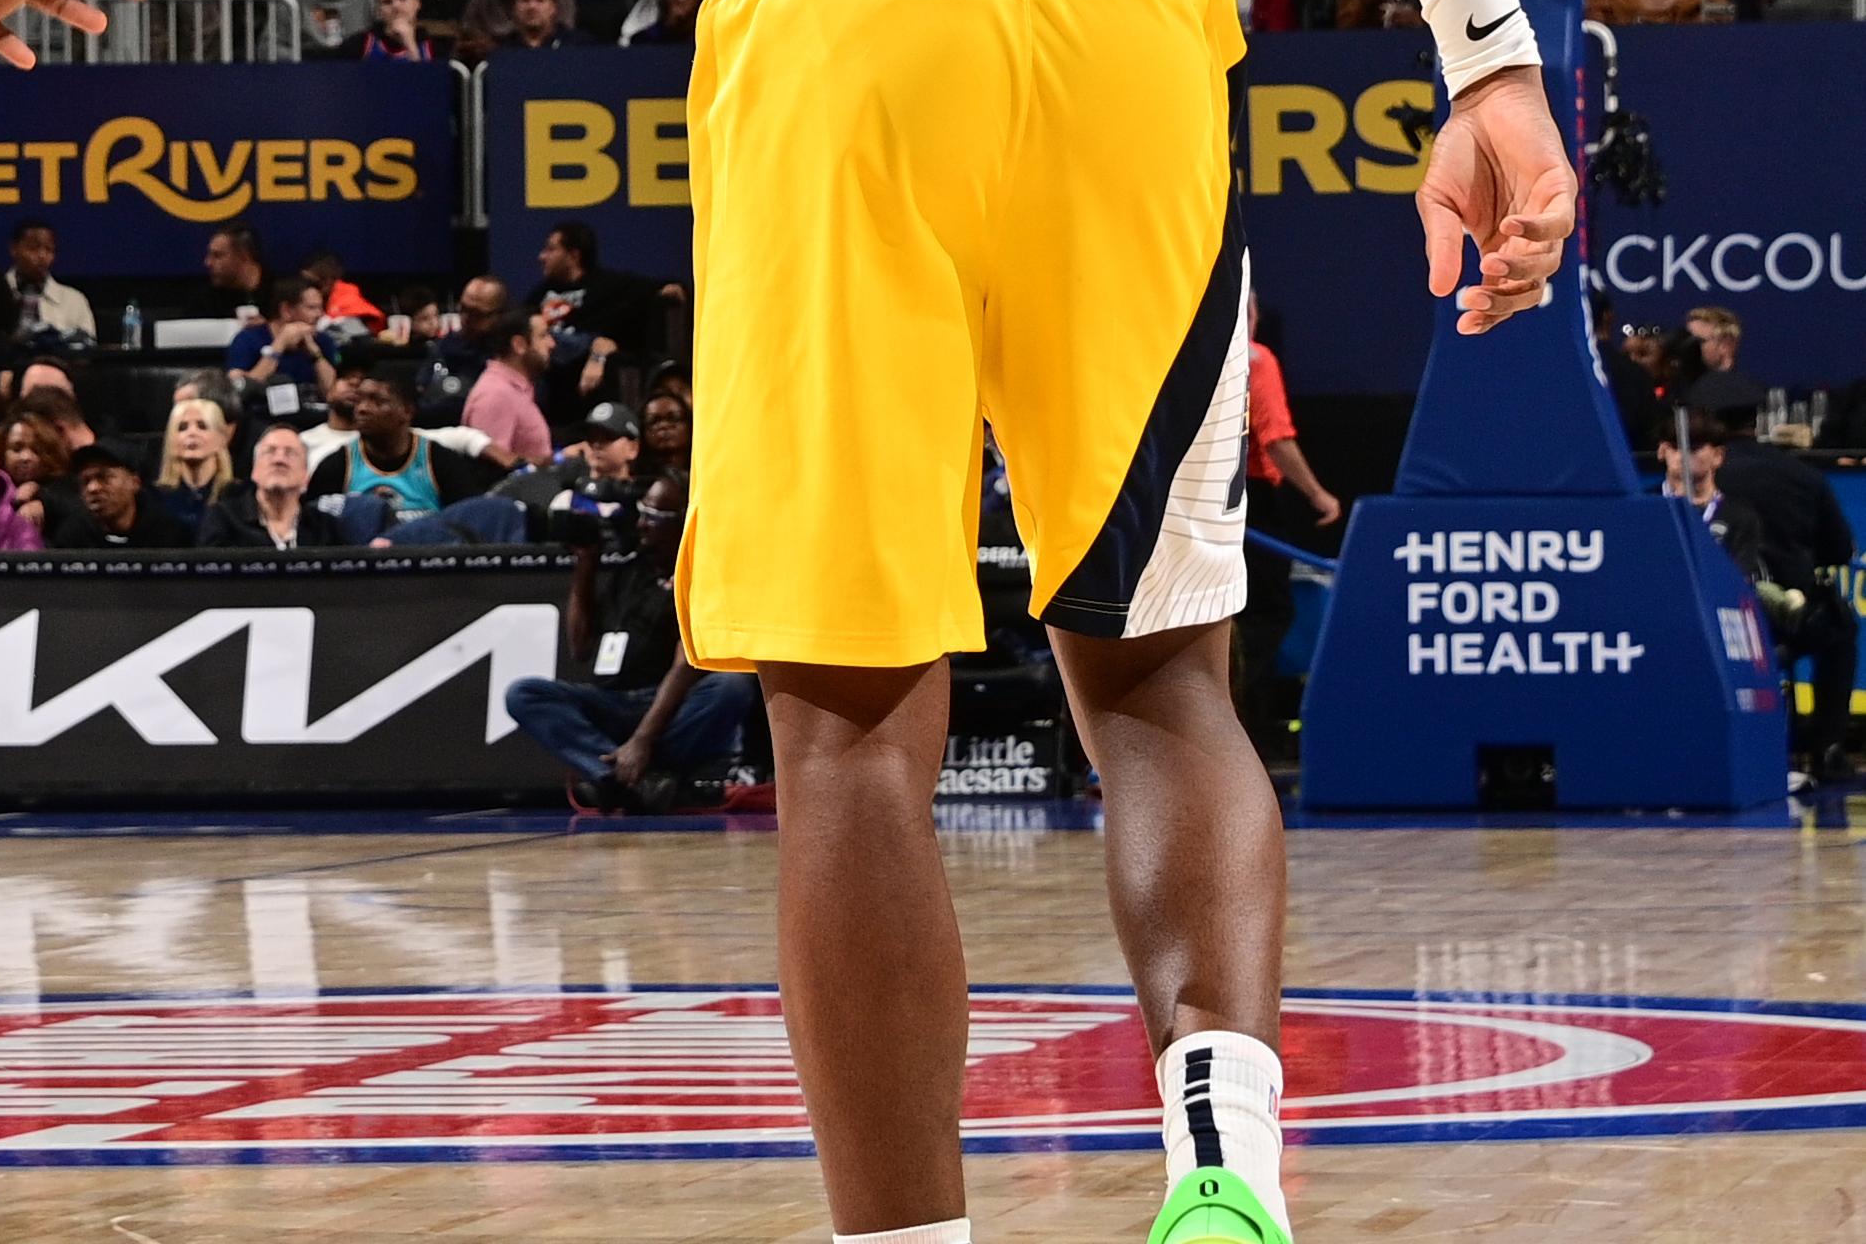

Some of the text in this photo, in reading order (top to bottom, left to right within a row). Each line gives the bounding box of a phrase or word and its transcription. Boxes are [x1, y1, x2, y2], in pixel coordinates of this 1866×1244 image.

[1232, 79, 1435, 196] RS
[1393, 530, 1604, 573] HENRY
[1407, 581, 1560, 623] FORD
[1408, 631, 1645, 674] HEALTH
[944, 735, 1035, 767] Little
[935, 766, 1048, 795] aesars
